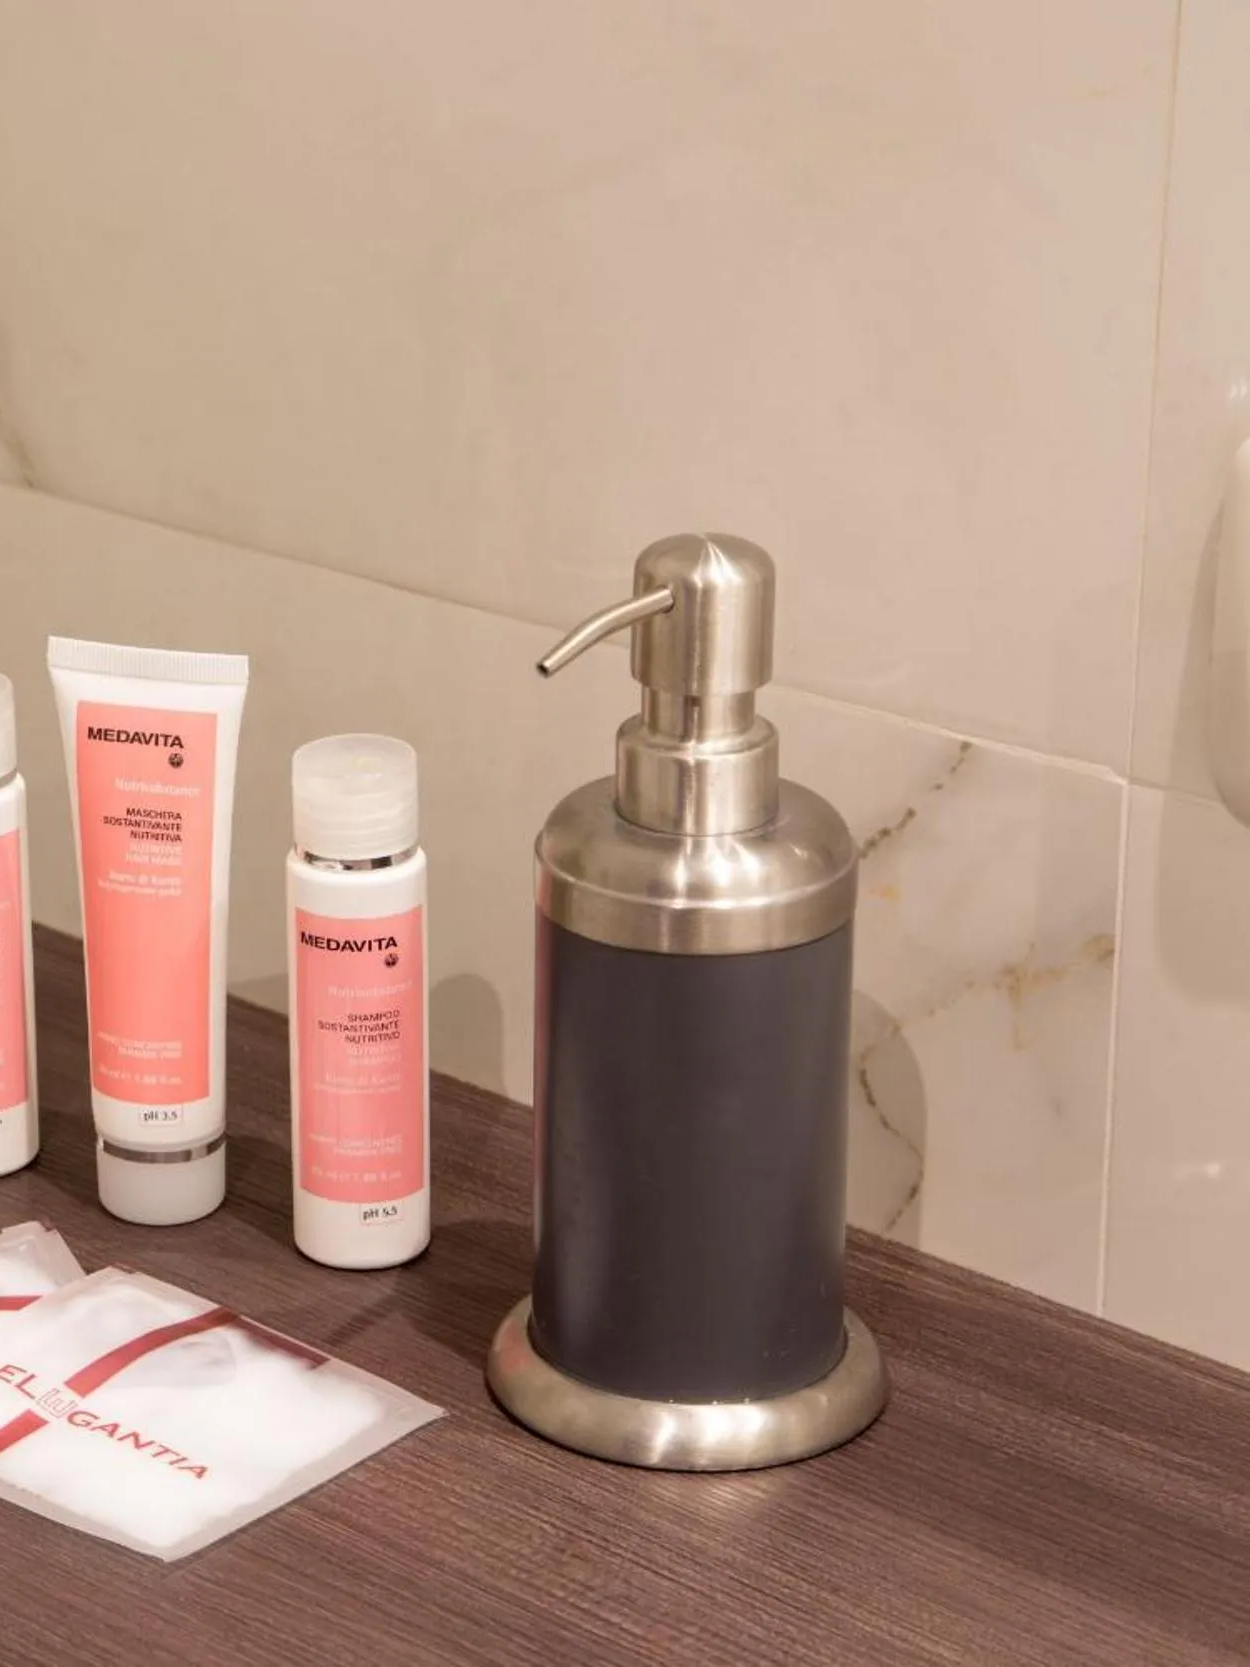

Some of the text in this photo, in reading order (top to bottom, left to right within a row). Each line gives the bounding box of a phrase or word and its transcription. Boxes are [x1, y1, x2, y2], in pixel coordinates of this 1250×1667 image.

[87, 726, 184, 748] MEDAVITA
[126, 807, 183, 820] MASCHERA
[300, 931, 398, 952] MEDAVITA
[363, 1208, 379, 1220] pH
